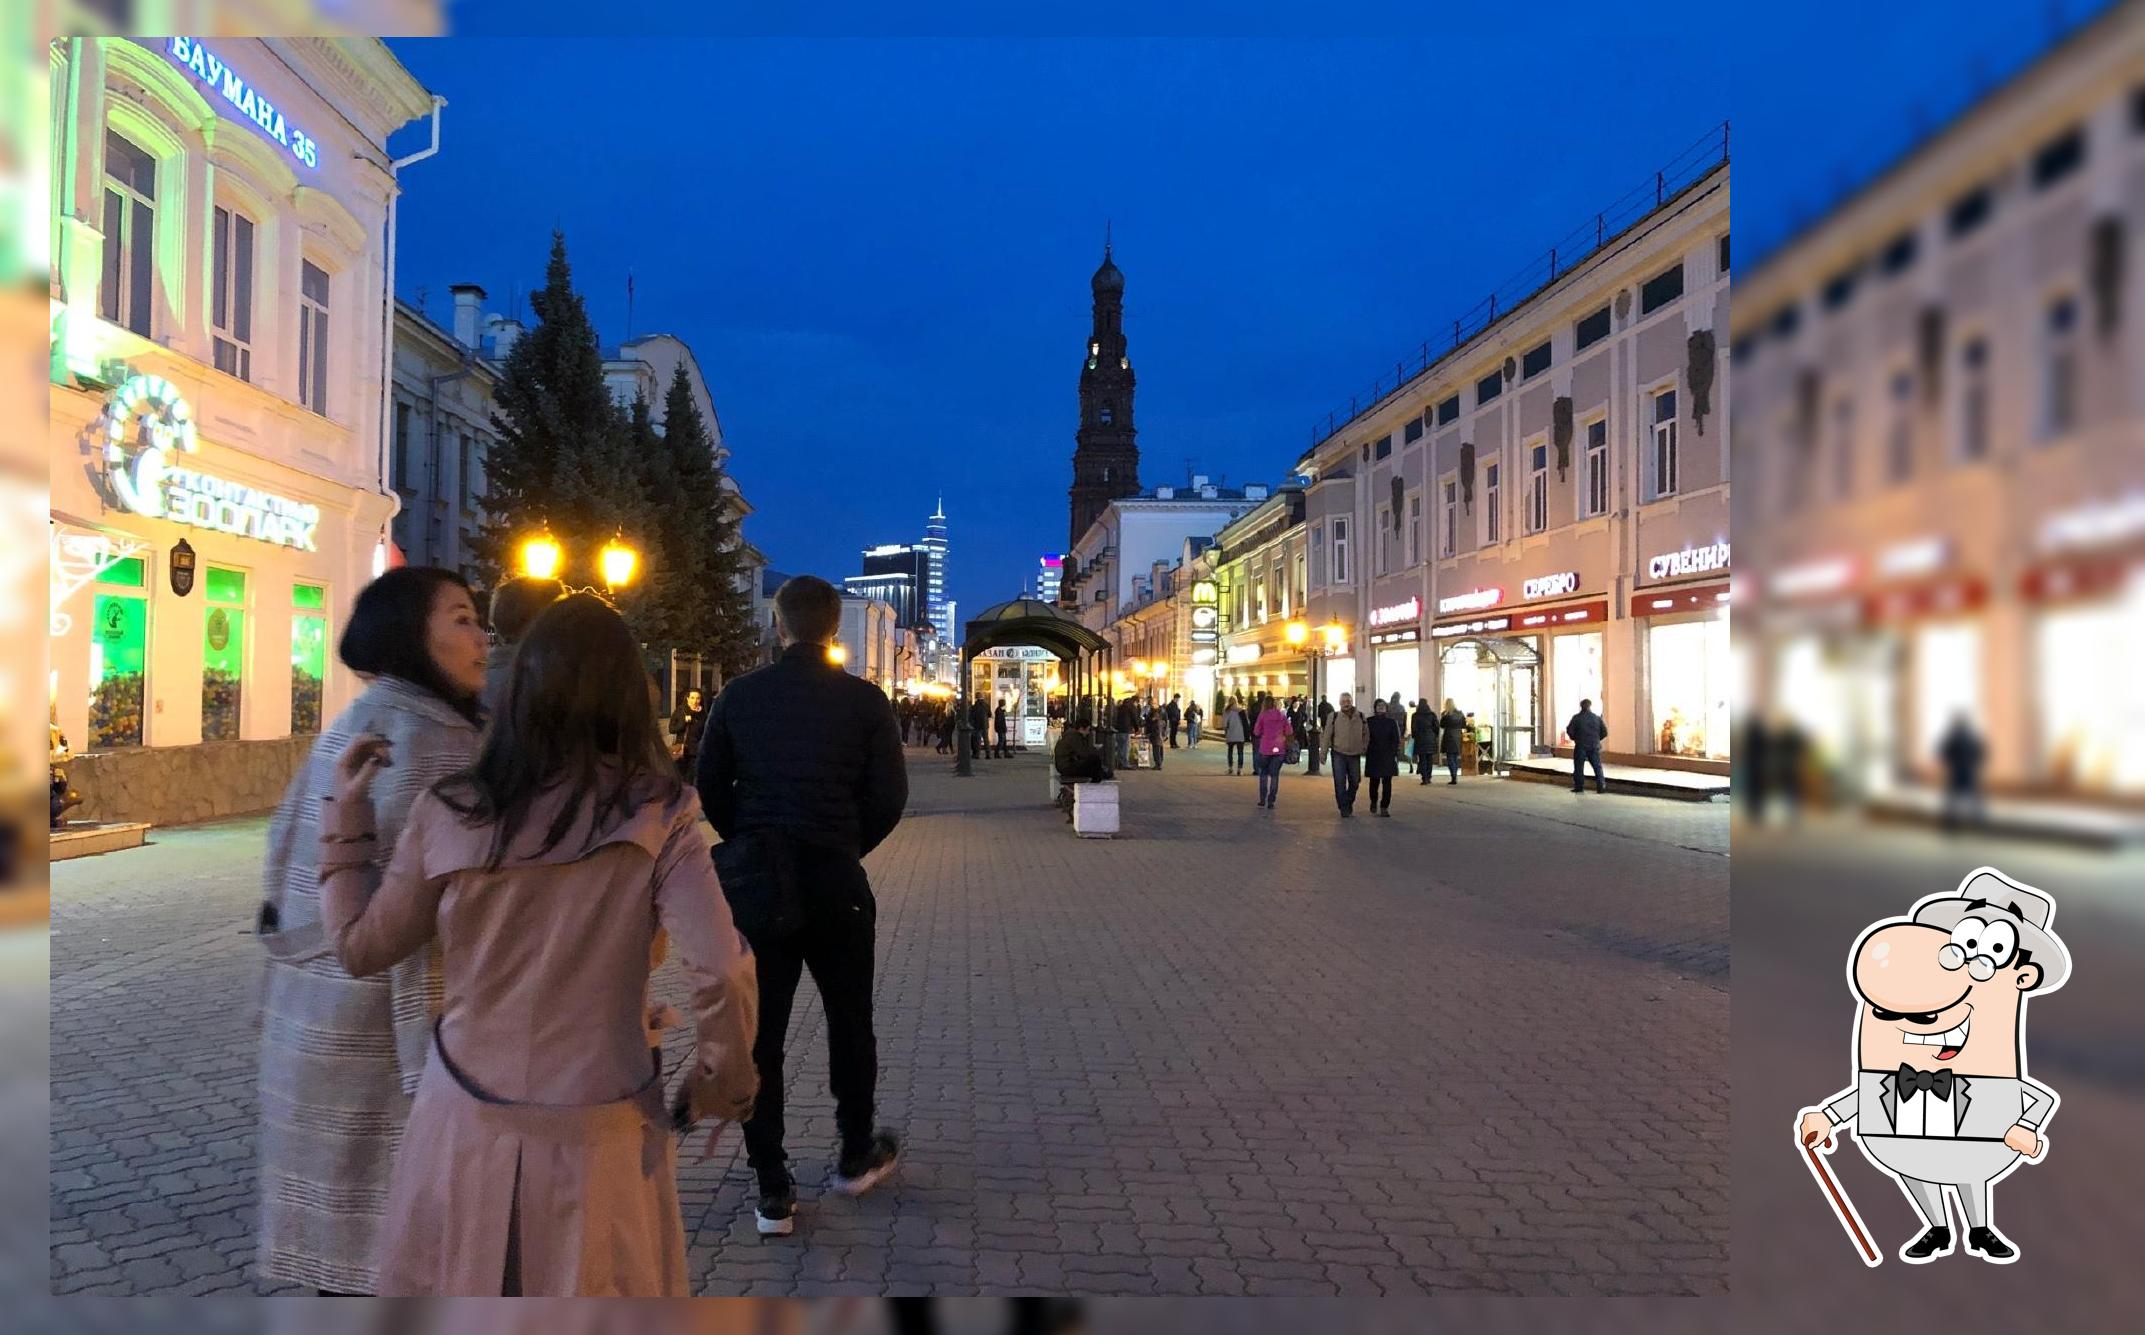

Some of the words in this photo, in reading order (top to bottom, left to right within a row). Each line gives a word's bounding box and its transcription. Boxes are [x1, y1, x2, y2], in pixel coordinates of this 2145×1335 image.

[173, 37, 288, 147] БАУМАНА
[293, 129, 317, 168] 35
[167, 485, 318, 553] ЗООПАРК
[1649, 543, 1731, 580] СУВЕНИР
